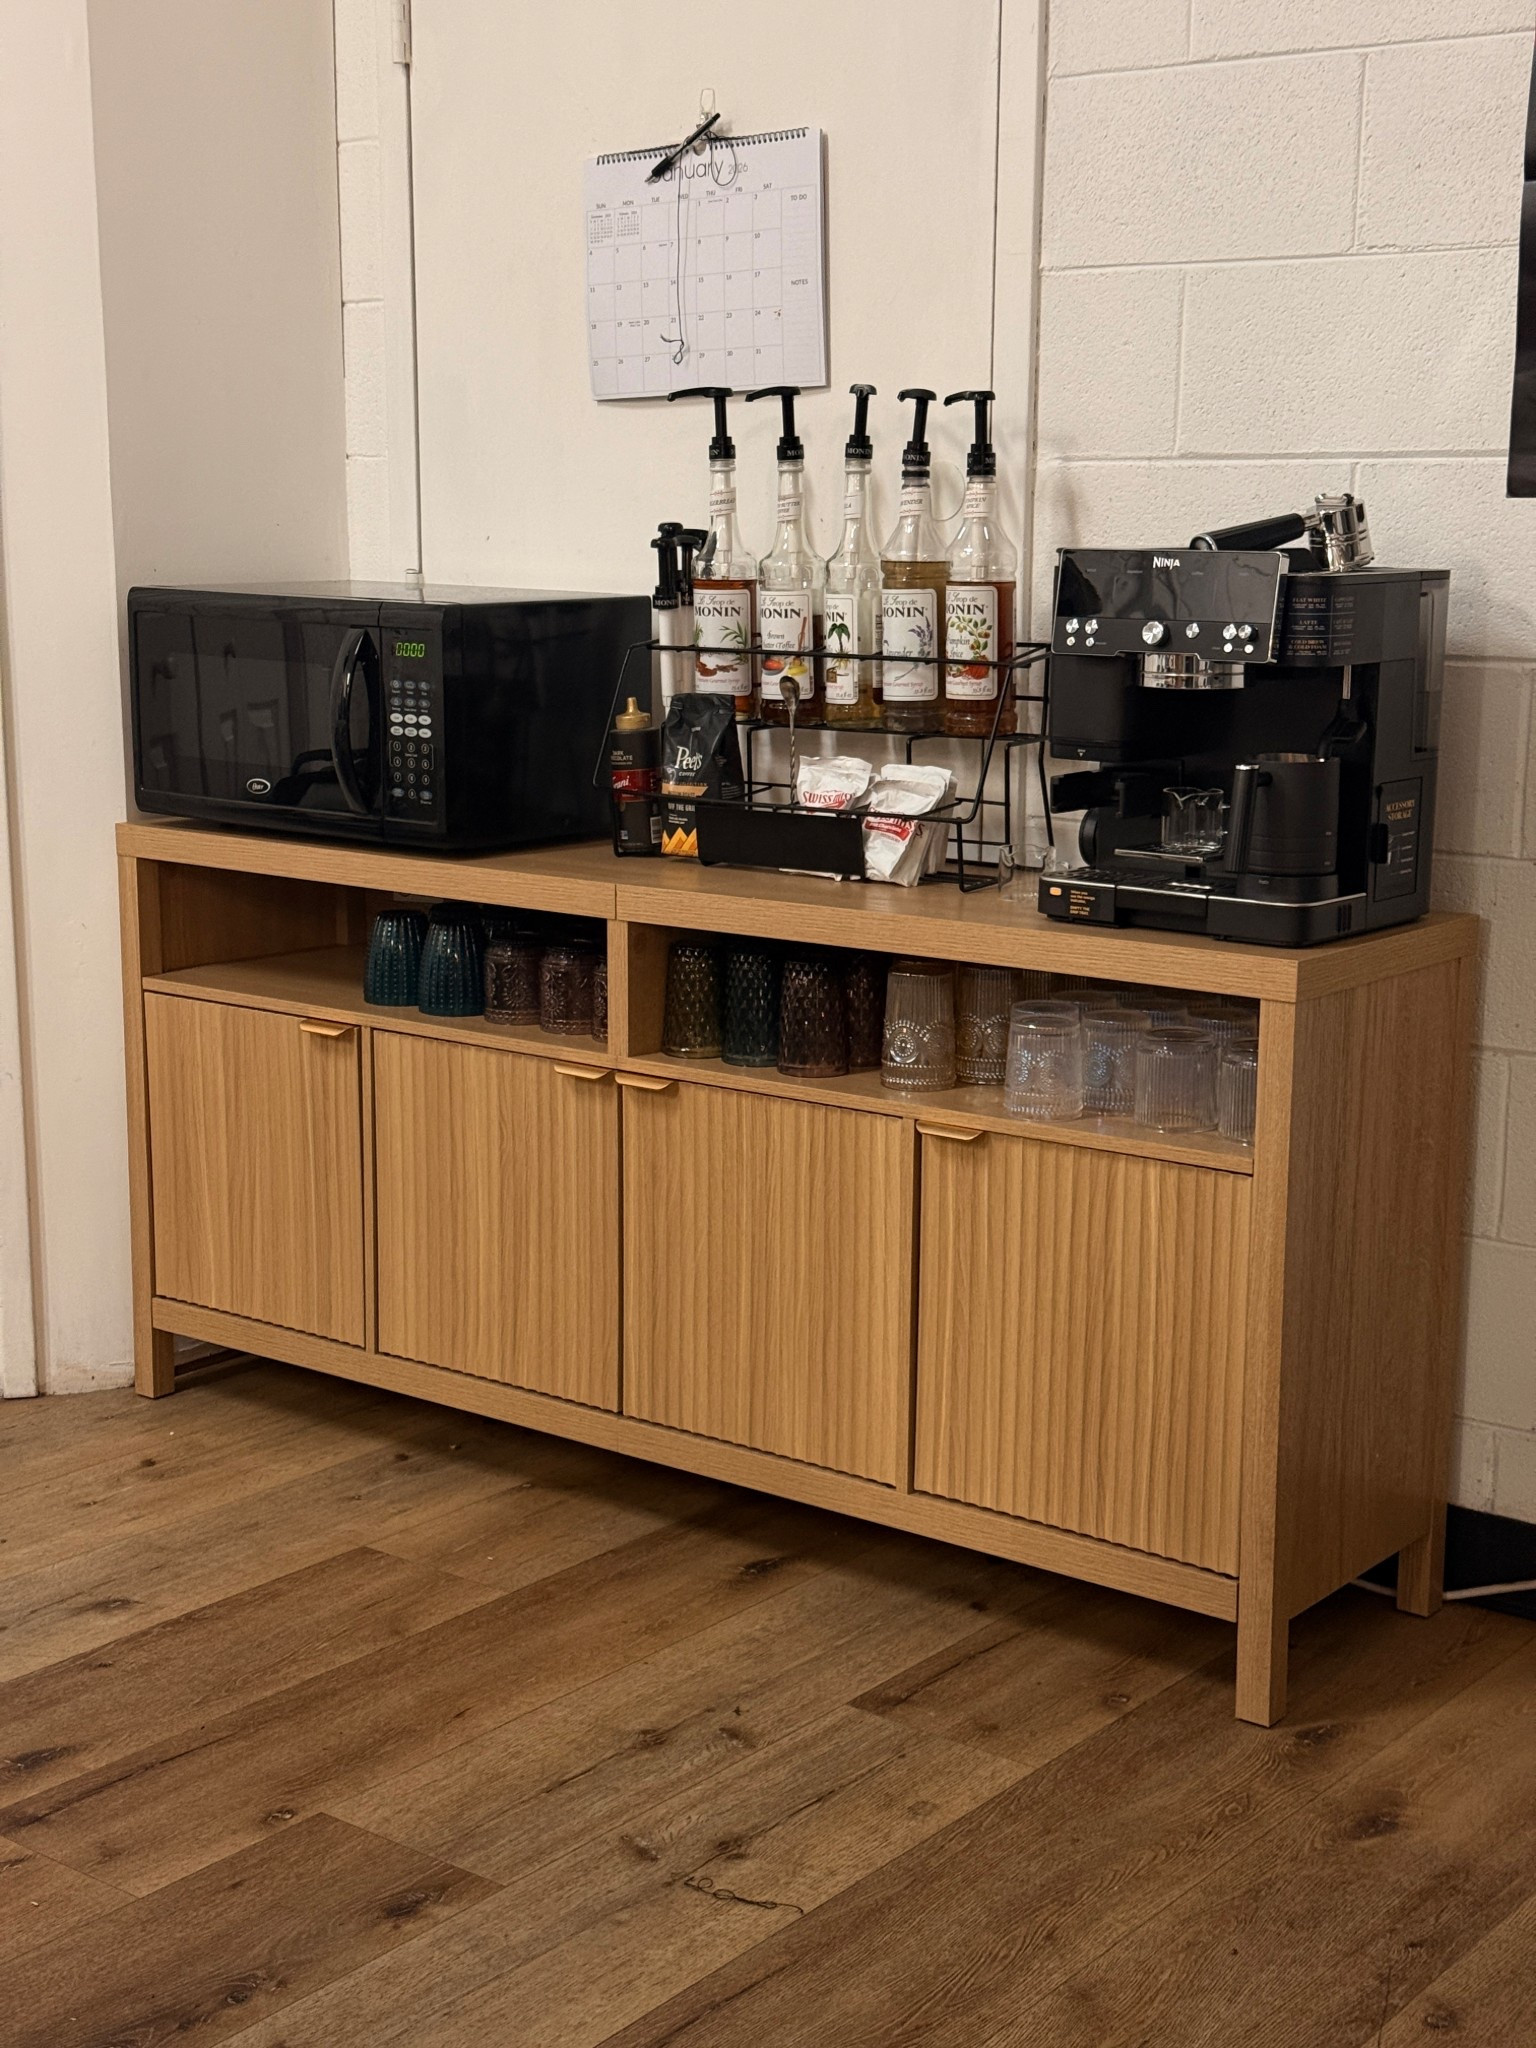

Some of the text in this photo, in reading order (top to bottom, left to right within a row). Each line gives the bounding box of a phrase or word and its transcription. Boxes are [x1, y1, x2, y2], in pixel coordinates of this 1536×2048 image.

[653, 160, 724, 183] anuary
[1153, 556, 1181, 570] NINJA
[825, 612, 845, 622] NIN
[767, 629, 785, 640] Brown
[395, 642, 425, 657] 0000
[685, 804, 695, 812] GRI
